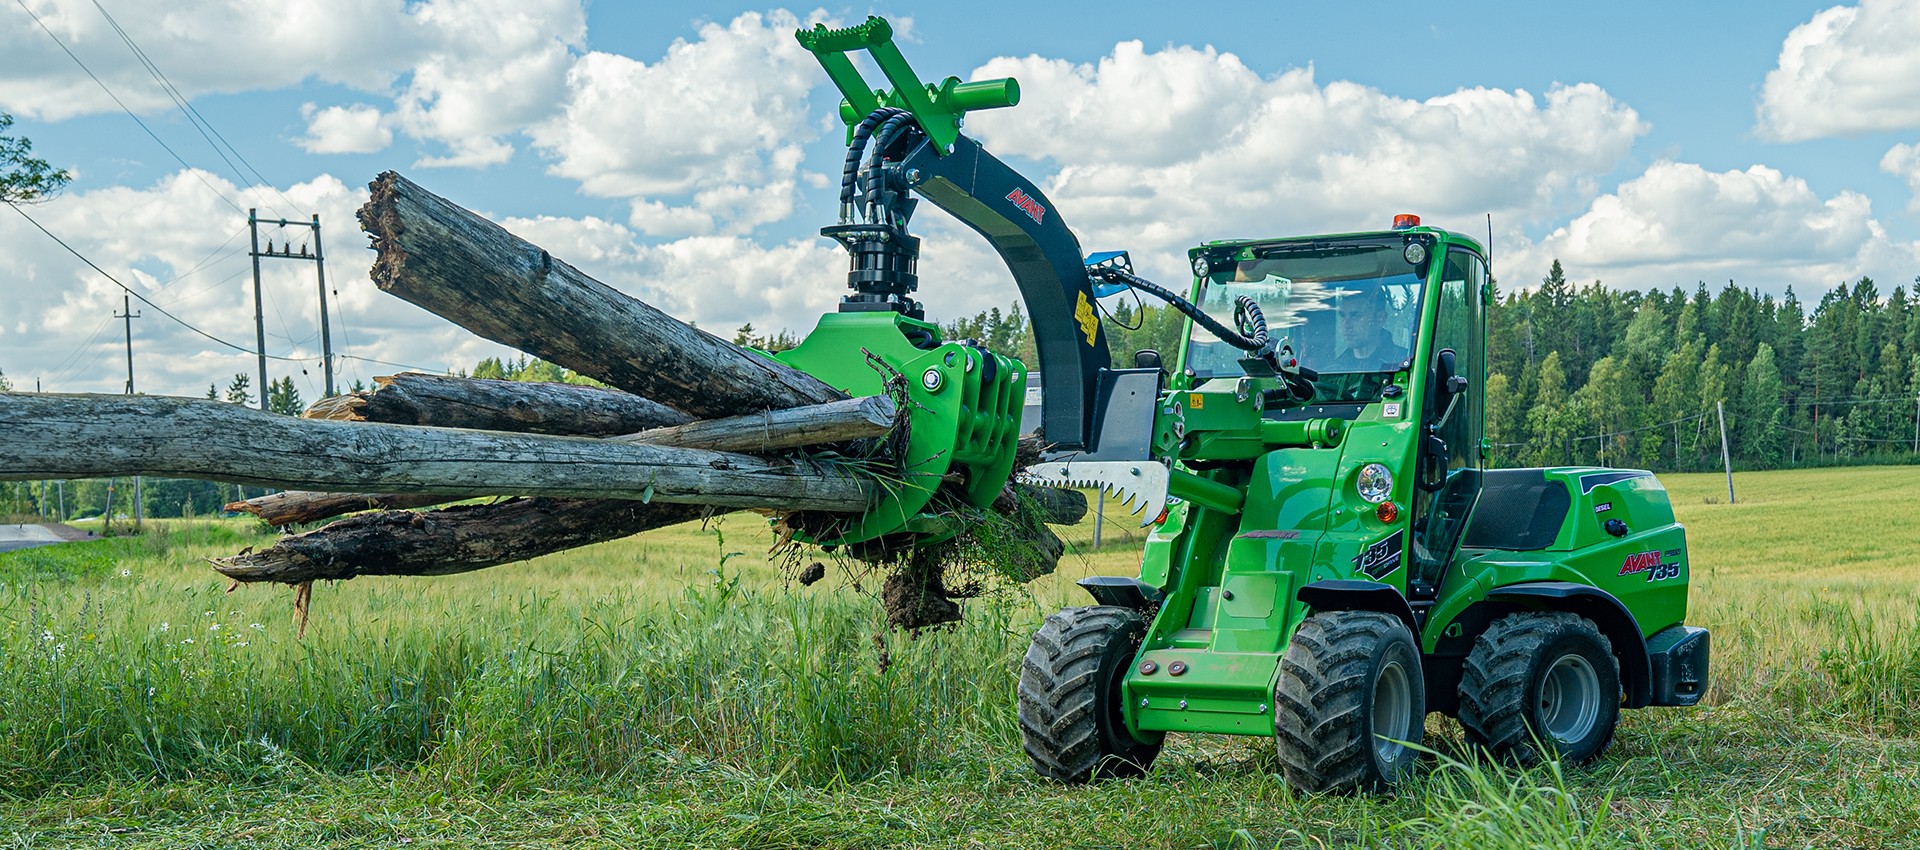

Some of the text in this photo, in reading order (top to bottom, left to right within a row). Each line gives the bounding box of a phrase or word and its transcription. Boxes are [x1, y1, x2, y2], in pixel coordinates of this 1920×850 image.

[1005, 187, 1046, 225] AVANT
[1351, 541, 1389, 573] 735
[1617, 550, 1662, 576] AVANT
[1646, 562, 1681, 583] 735
